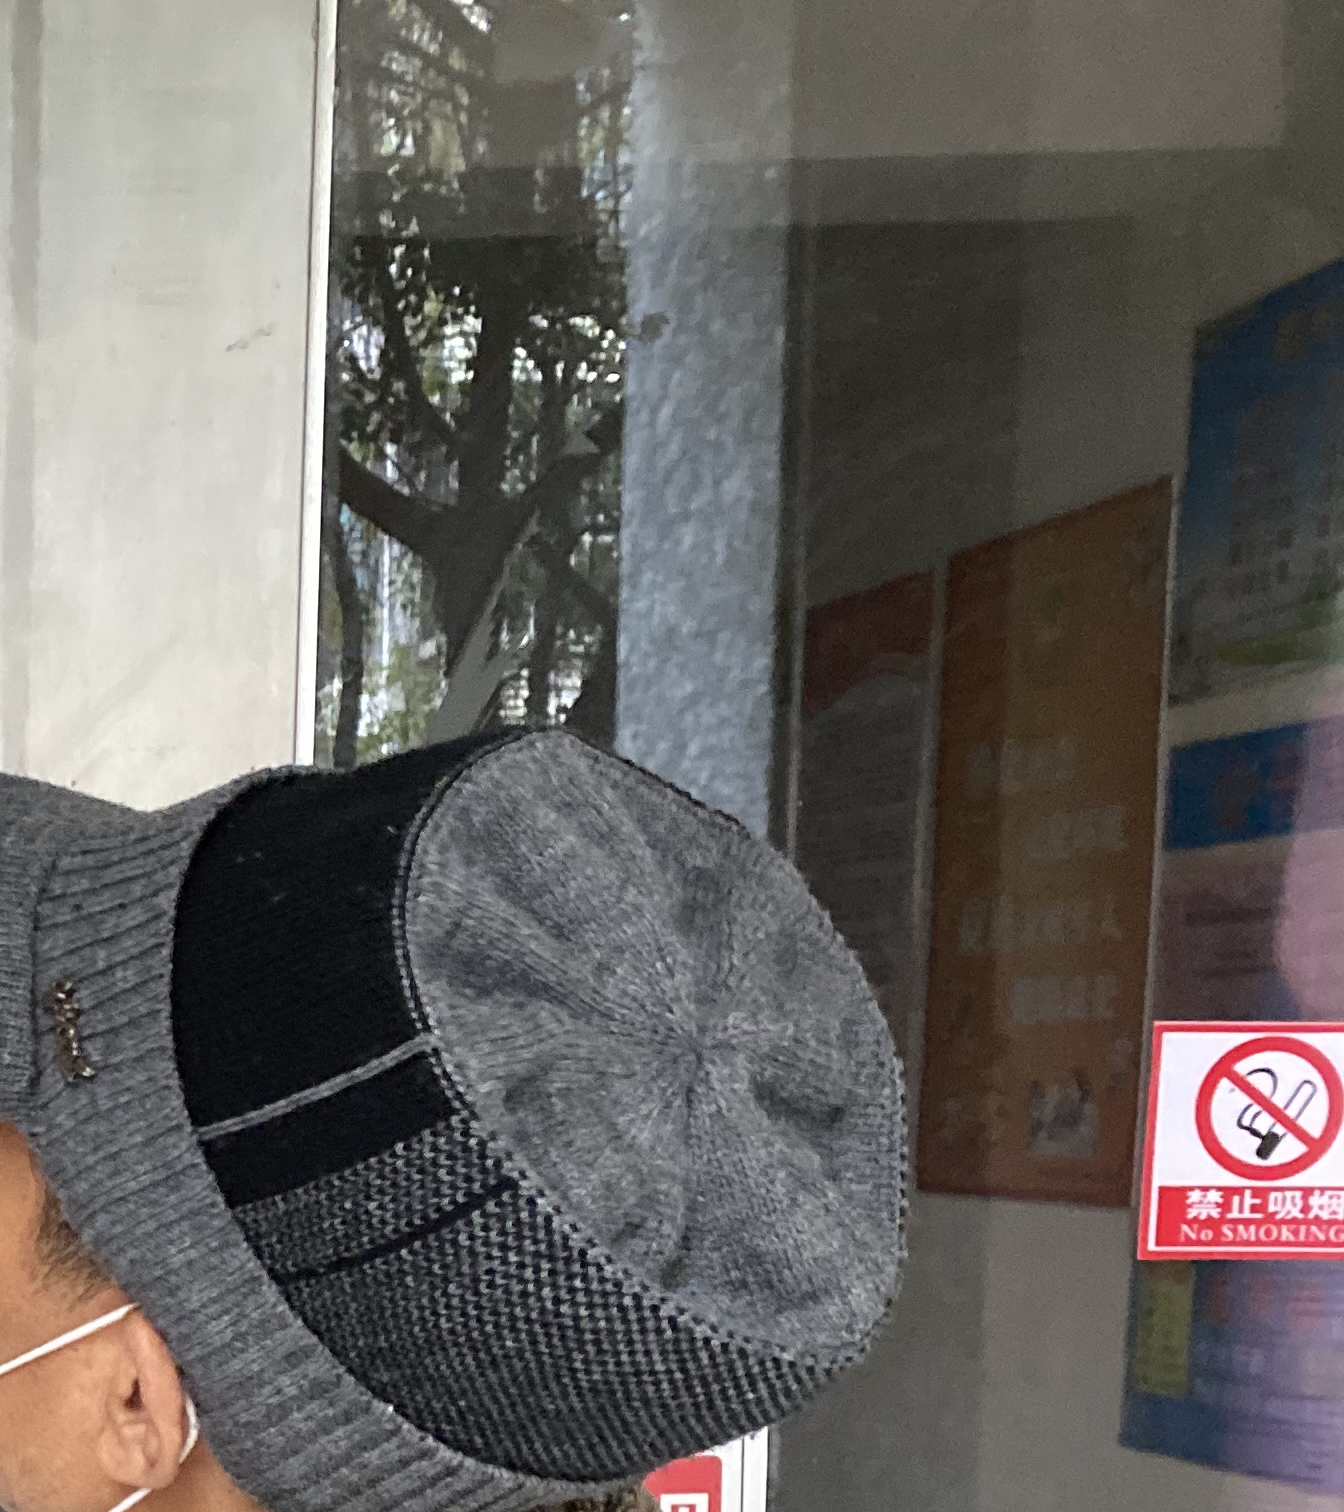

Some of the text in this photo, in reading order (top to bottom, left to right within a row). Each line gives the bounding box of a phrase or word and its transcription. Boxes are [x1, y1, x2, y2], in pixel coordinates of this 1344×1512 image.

[1186, 1189, 1344, 1220] 禁止吸烟
[1180, 1224, 1344, 1243] No SMOKING
